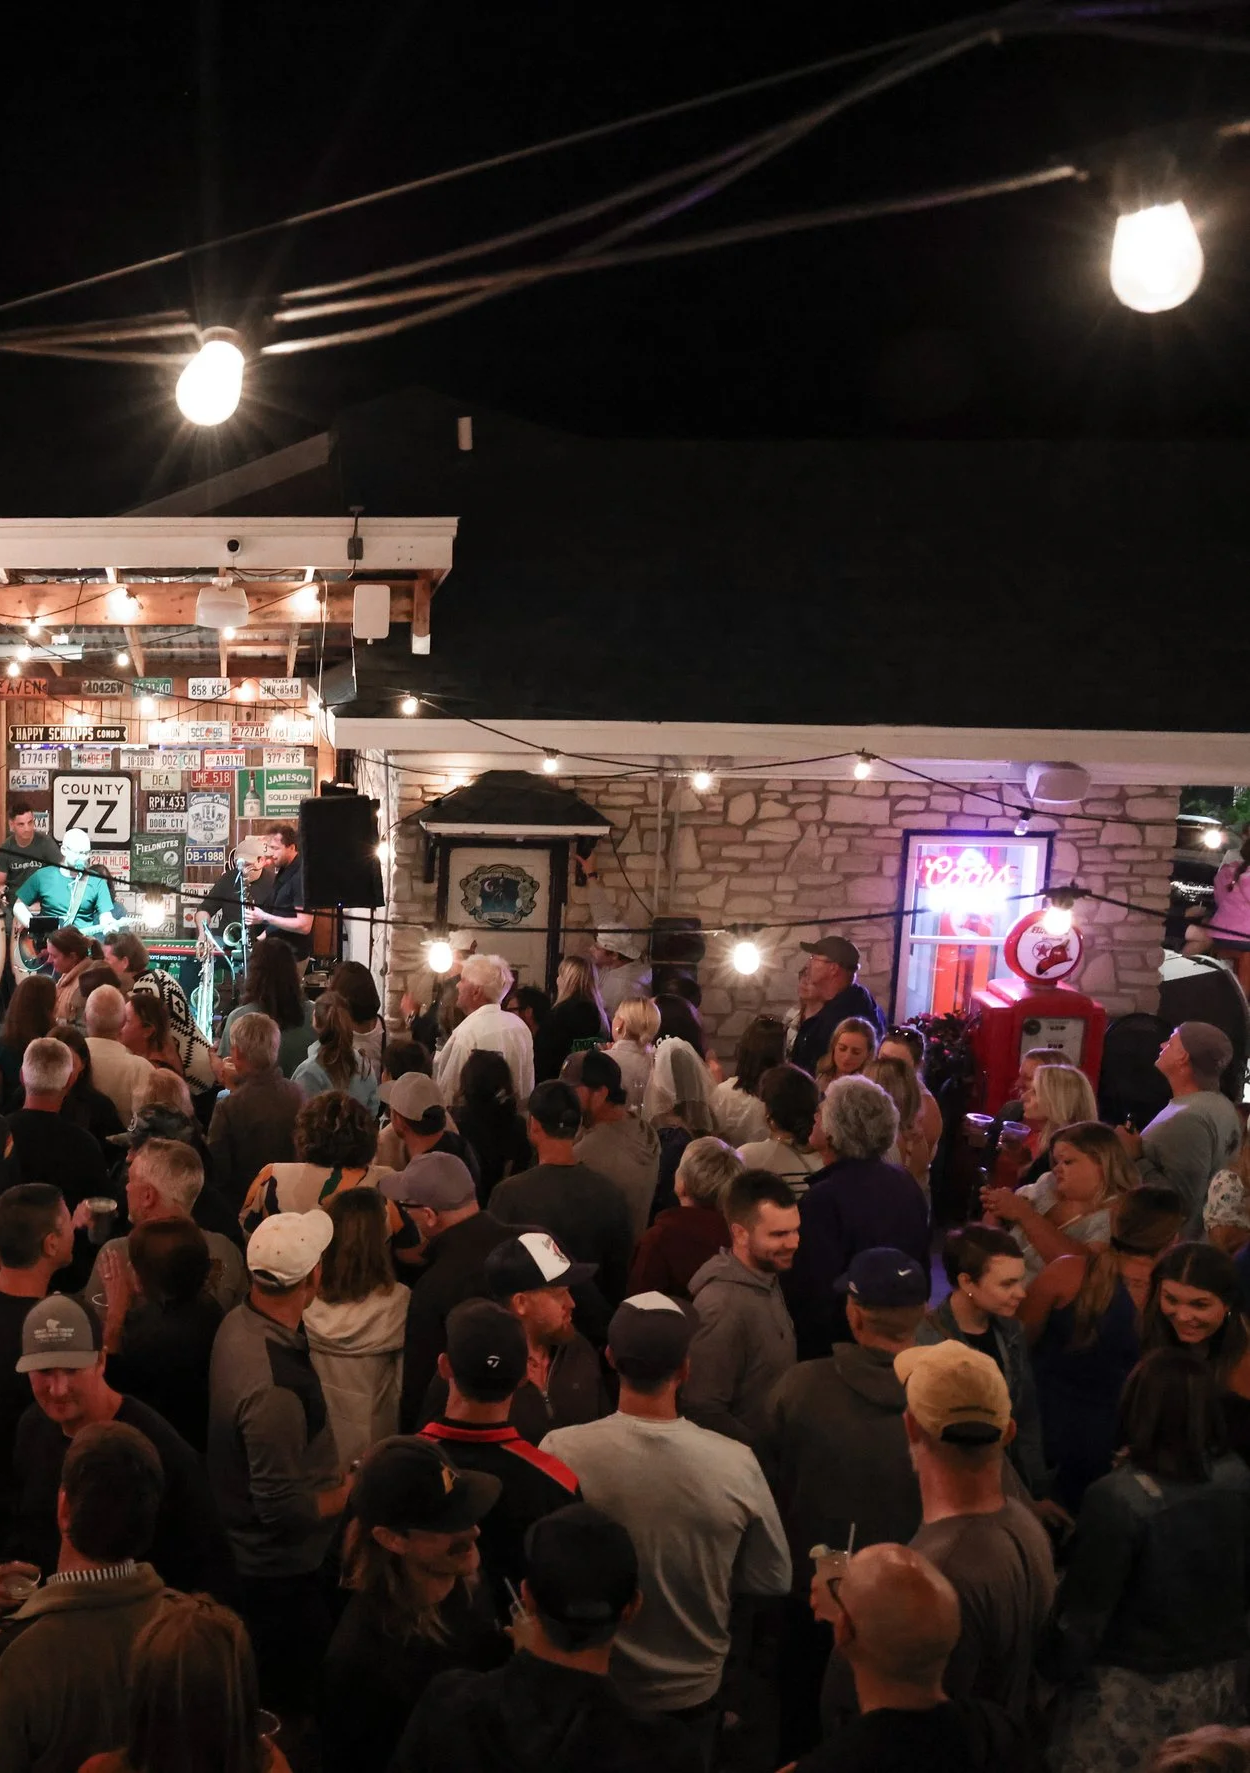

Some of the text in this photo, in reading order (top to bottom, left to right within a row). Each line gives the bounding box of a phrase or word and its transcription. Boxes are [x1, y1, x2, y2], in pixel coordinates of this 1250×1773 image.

[191, 686, 207, 696] 858
[16, 727, 120, 741] HAPPY SCHNAPPS COMBO
[11, 775, 47, 785] 665 HYK
[152, 775, 170, 785] DEA
[213, 773, 230, 783] 518
[267, 773, 309, 785] JAMESON
[61, 783, 124, 795] COUNTY
[268, 793, 288, 801] SOLD
[65, 799, 118, 834] ZZ
[135, 839, 179, 856] FIELDNOTES
[924, 855, 1016, 888] Coors
